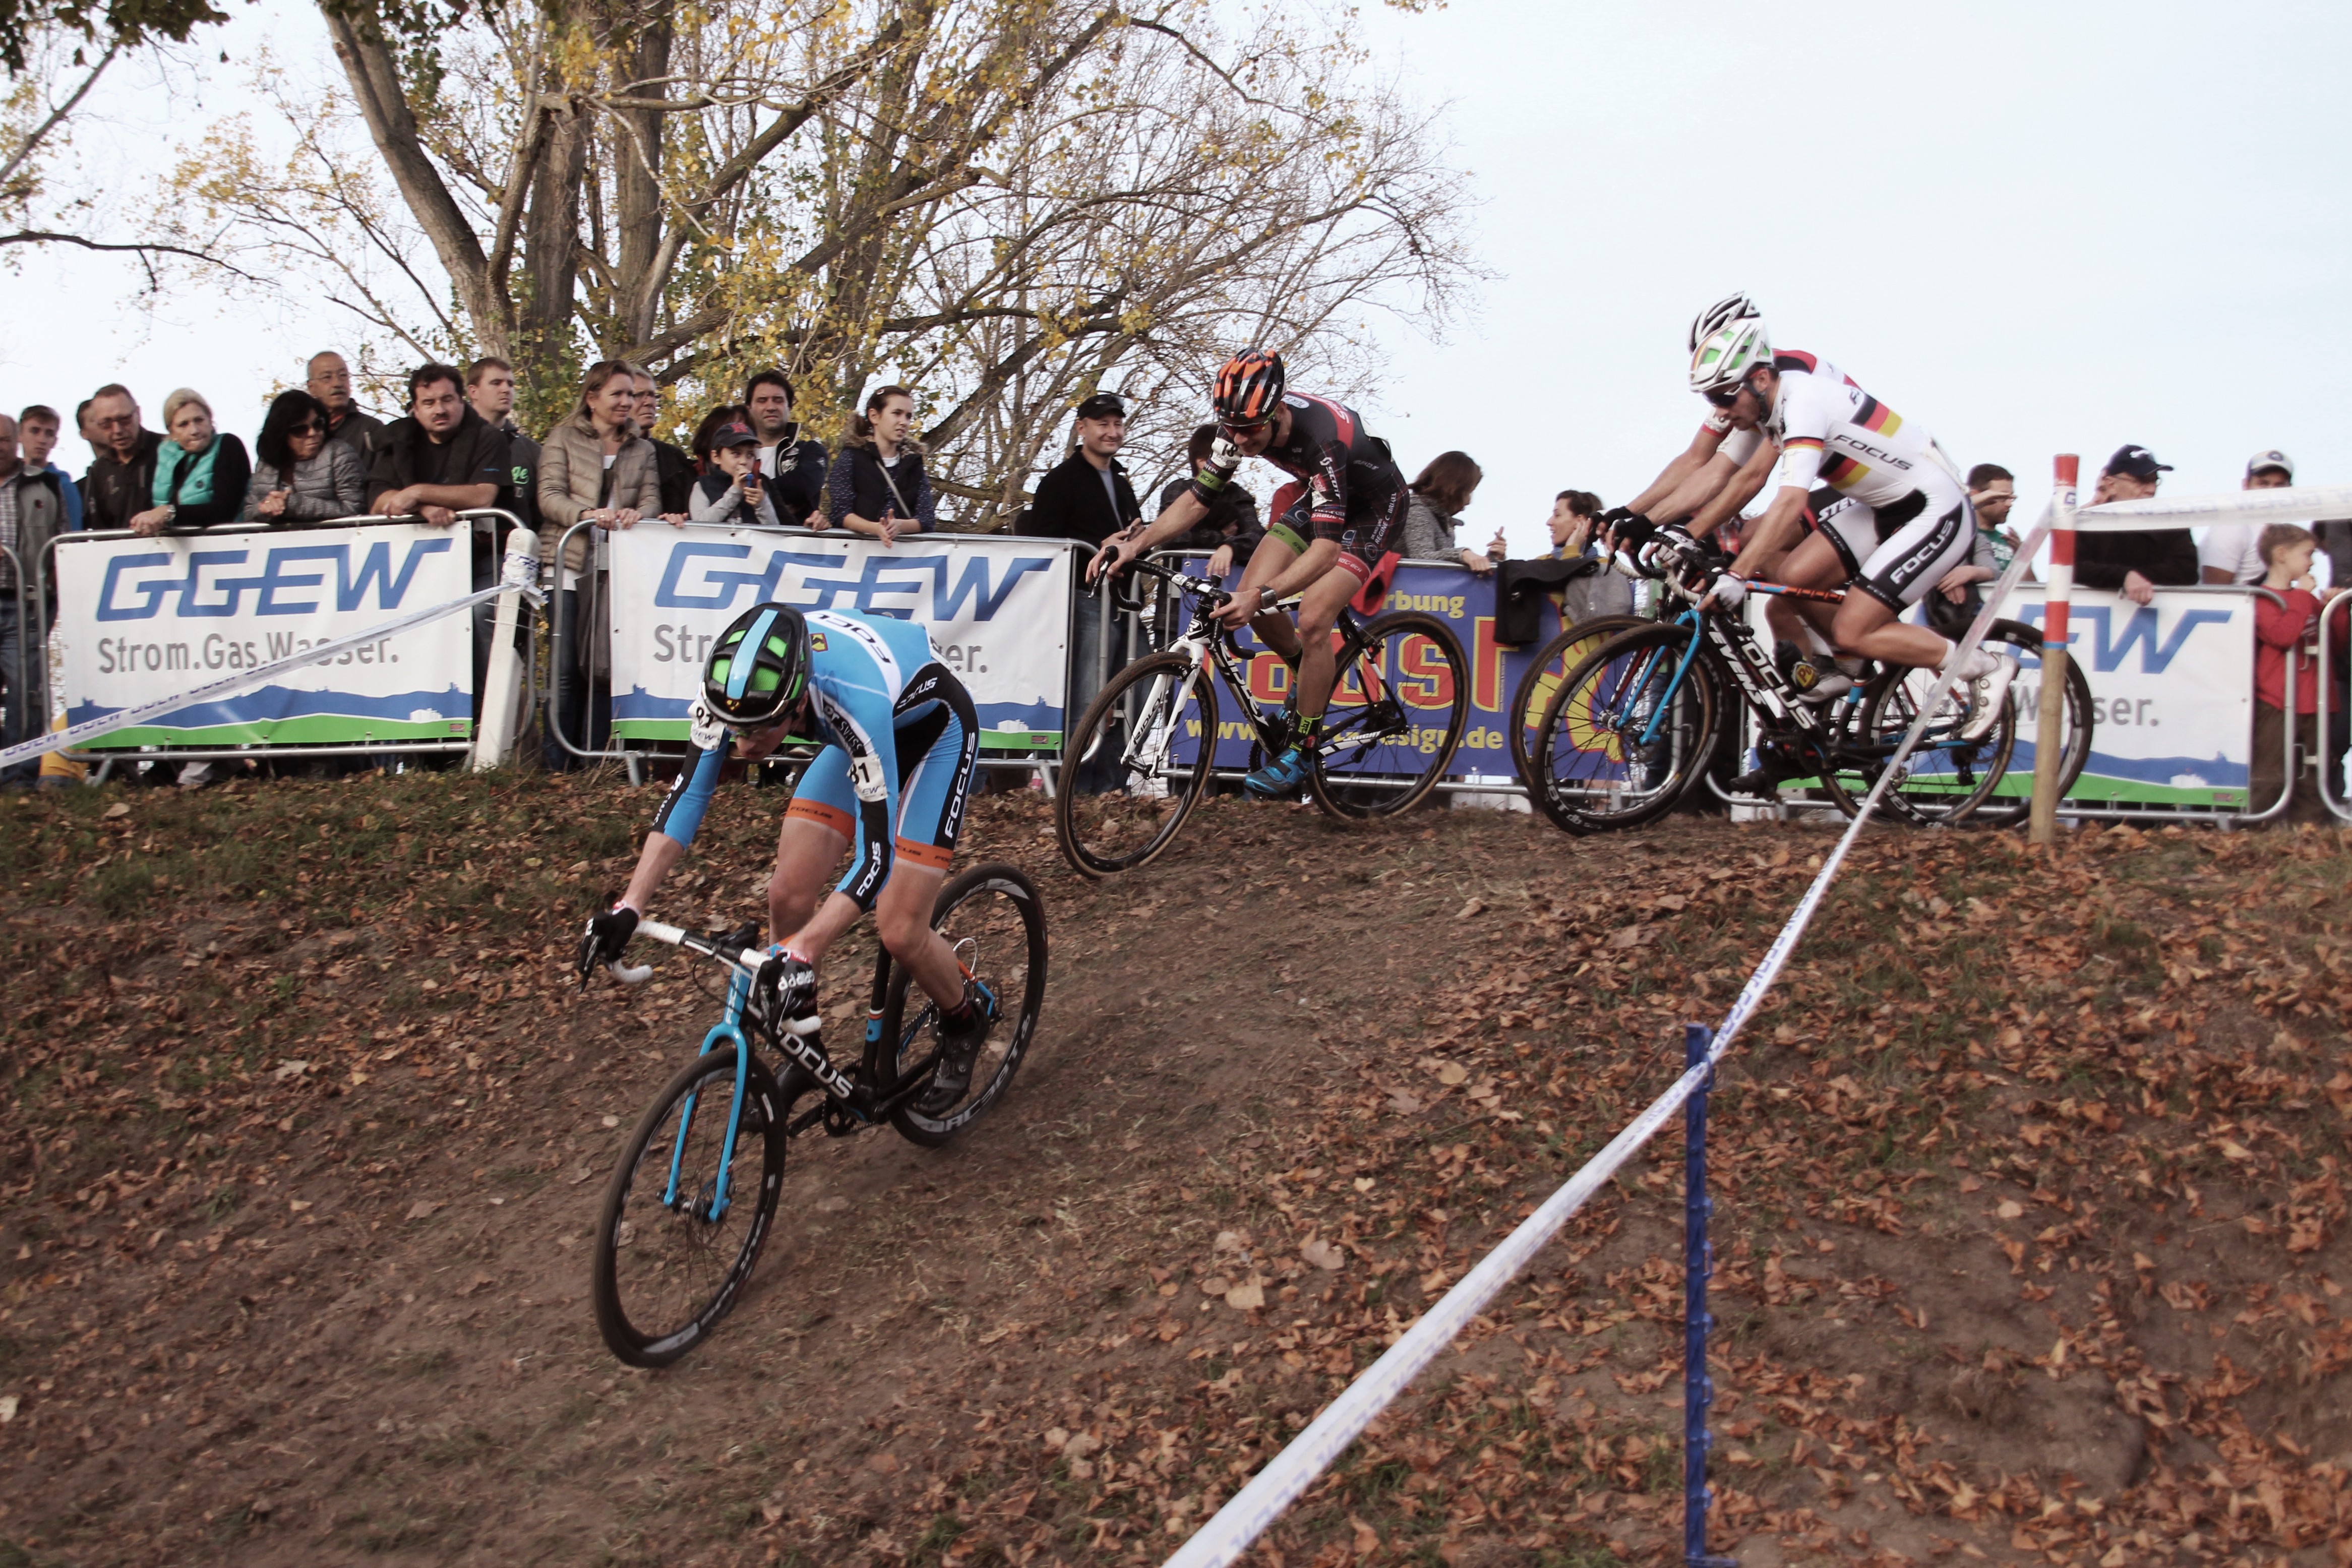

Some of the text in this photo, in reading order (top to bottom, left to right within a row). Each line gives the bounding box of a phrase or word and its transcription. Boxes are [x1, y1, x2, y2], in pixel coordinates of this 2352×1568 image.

[1834, 433, 1914, 471] FOCUS
[97, 537, 454, 622] GGEW
[654, 541, 1052, 622] GGEW
[1890, 518, 1955, 585] FOCUS
[1382, 590, 1465, 619] rbung
[2009, 604, 2233, 674] EW
[790, 807, 832, 819] FOCUS
[944, 732, 976, 838] FOCUS
[856, 840, 881, 897] FOCUS
